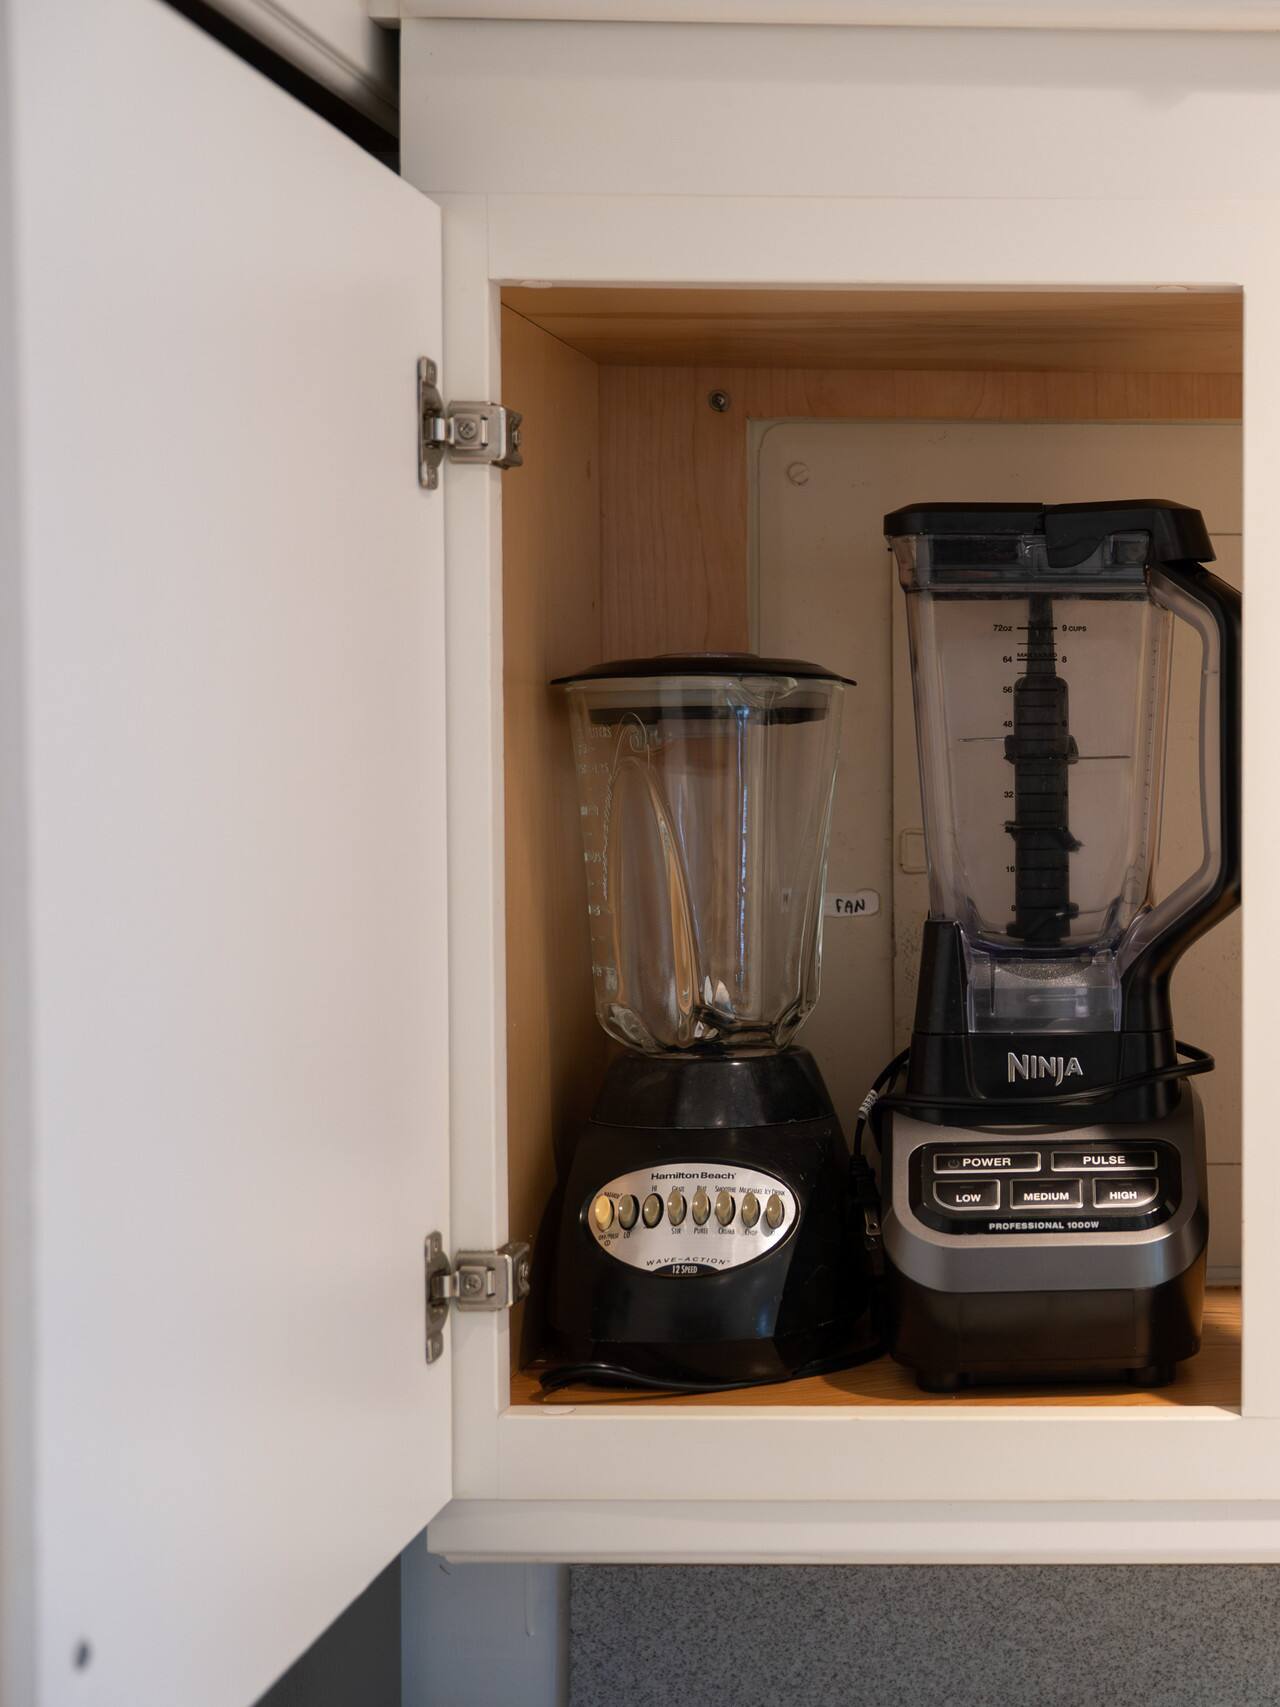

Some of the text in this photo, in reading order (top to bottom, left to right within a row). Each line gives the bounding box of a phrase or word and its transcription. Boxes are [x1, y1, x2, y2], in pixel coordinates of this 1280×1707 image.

[993, 624, 1013, 632] 72oz
[1062, 624, 1067, 632] 9
[1002, 686, 1013, 694] 56
[1003, 720, 1013, 728] 48
[835, 898, 865, 914] FAN
[1007, 1052, 1084, 1086] NINJA
[962, 1157, 1012, 1167] POWER
[1083, 1155, 1126, 1165] PULSE
[651, 1171, 736, 1181] Hamilton Beach
[955, 1194, 982, 1203] LOW
[1023, 1192, 1070, 1201] MEDIUM
[1109, 1191, 1138, 1200] HIGH
[988, 1220, 1100, 1231] PROFESSIONAL 1000W
[672, 1264, 698, 1274] 12 SPEED
